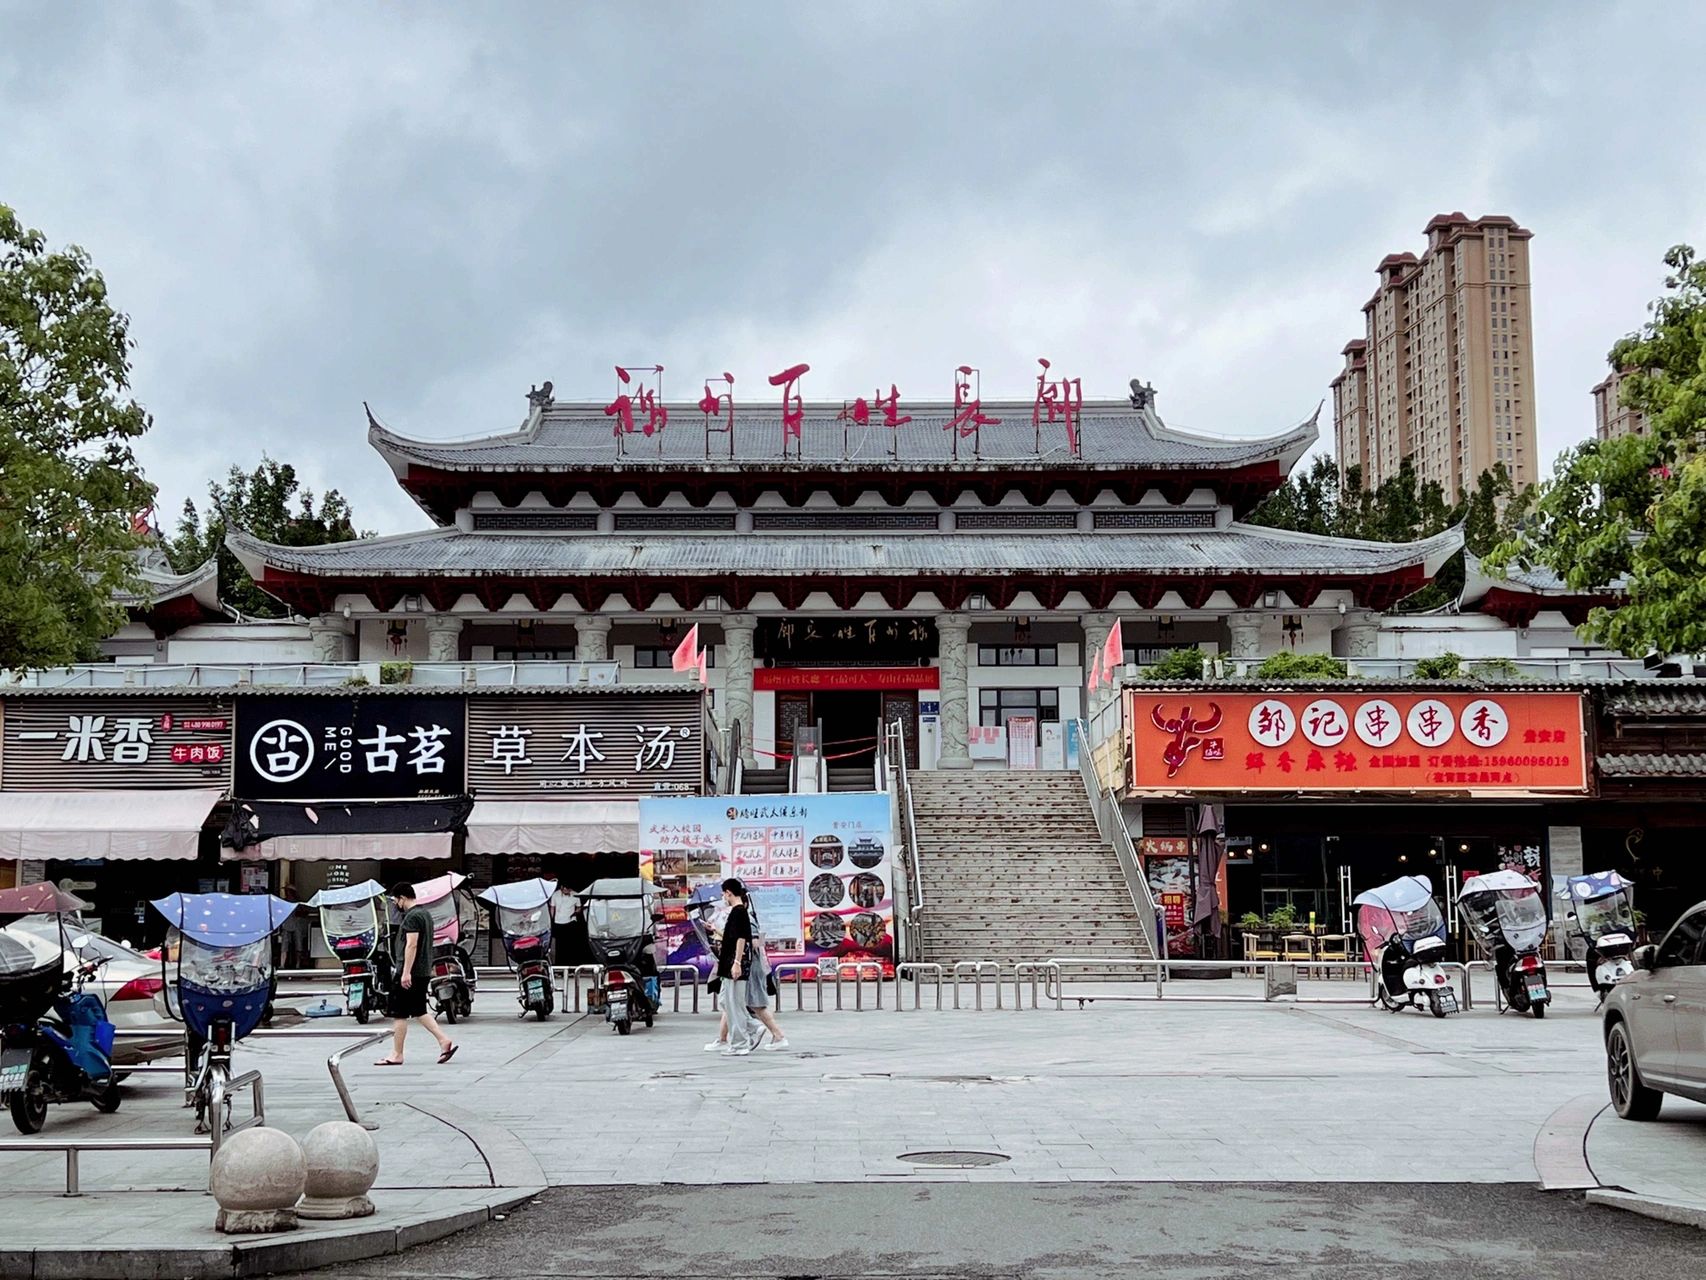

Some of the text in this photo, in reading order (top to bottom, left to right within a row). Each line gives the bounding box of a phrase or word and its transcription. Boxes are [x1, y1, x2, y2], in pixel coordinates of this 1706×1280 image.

[18, 715, 155, 764] 一米香
[1257, 705, 1499, 742] 邹记串串香
[173, 746, 221, 760] 牛肉饭
[339, 726, 353, 774] GOOD
[357, 724, 452, 774] 古茗
[483, 724, 676, 775] 草本汤
[1245, 749, 1358, 774] 鲜香麻辣
[1146, 840, 1198, 854] 火锅串
